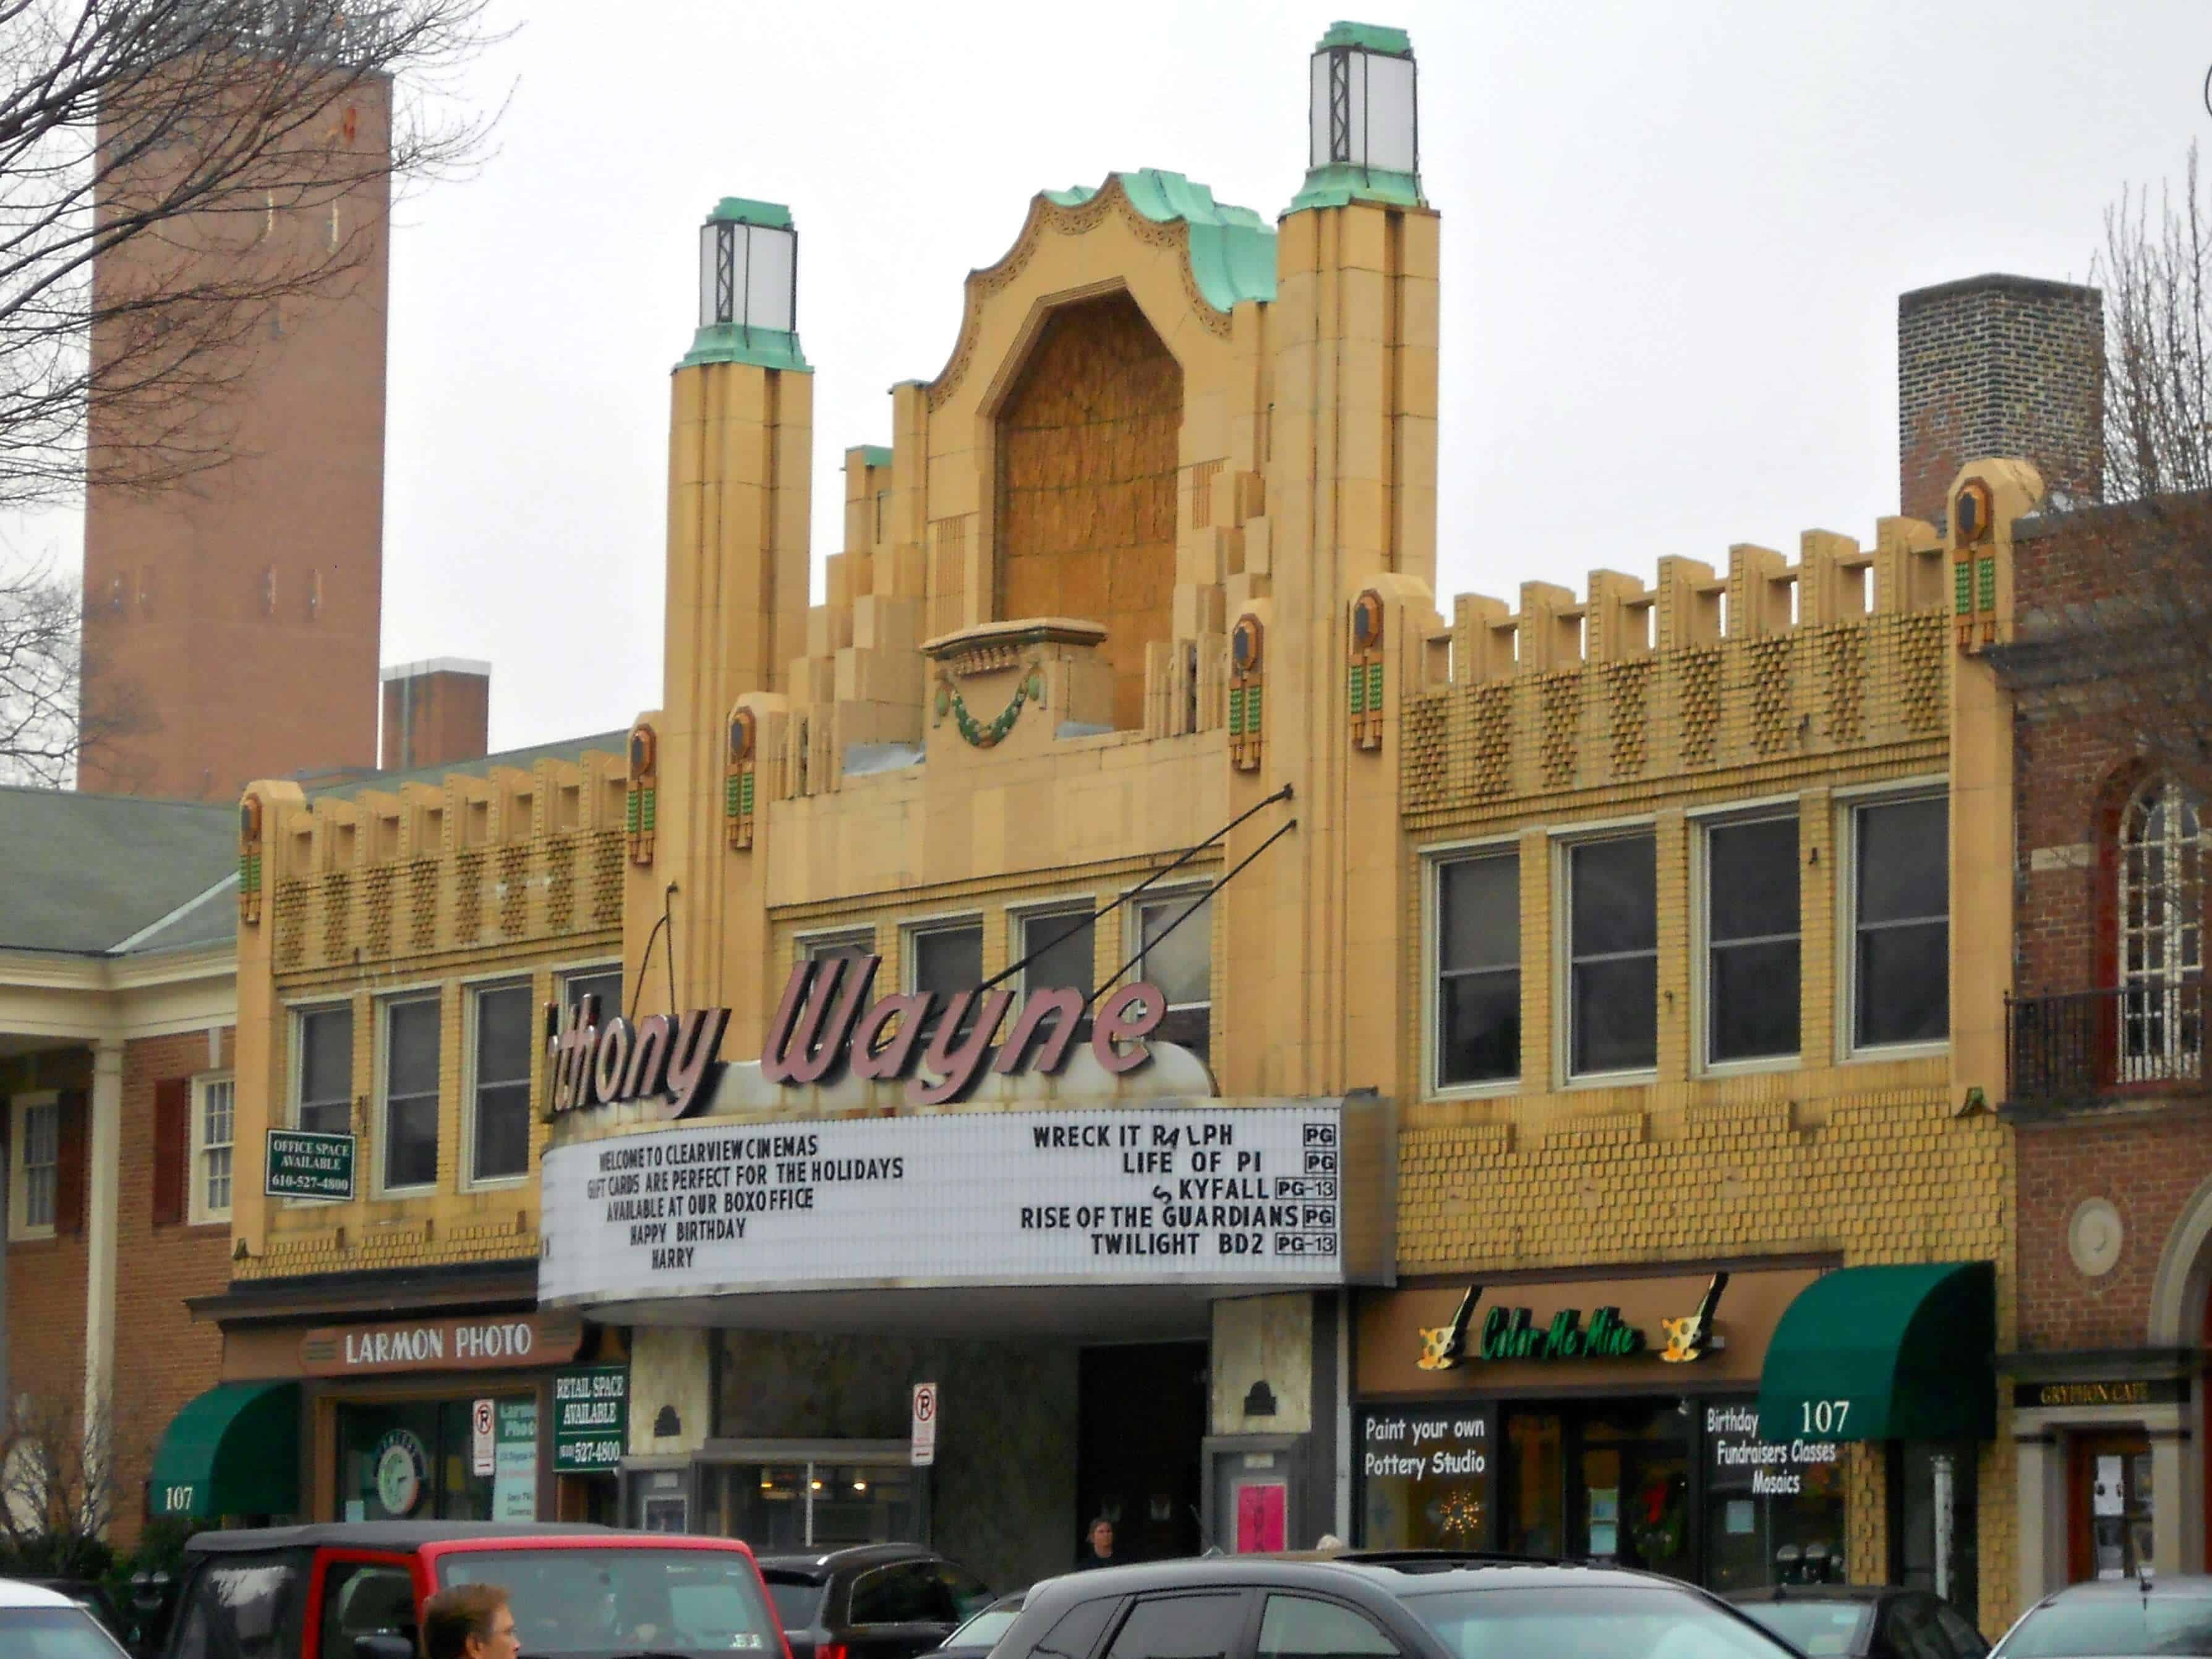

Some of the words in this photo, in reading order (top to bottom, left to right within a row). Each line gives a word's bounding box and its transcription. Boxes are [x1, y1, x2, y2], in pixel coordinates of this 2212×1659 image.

[761, 954, 1168, 1104] Wayne
[273, 1140, 314, 1154] OFFICE
[316, 1143, 349, 1157] SPACE
[1033, 1125, 1111, 1148] WRECK
[1119, 1125, 1141, 1147] IT
[1153, 1124, 1232, 1149] RALPH
[1305, 1128, 1333, 1143] PG
[280, 1155, 342, 1171] AVAILABLE
[665, 1140, 743, 1166] CLEARVIEW
[746, 1135, 818, 1159] CINEMAS
[1123, 1151, 1172, 1174] LIFE
[1191, 1151, 1222, 1173] OF
[1237, 1151, 1262, 1172] PI
[1307, 1155, 1334, 1170] PG
[271, 1174, 349, 1191] 610-527-4800
[587, 1178, 606, 1200] GIFT
[608, 1174, 639, 1196] CARDS
[645, 1171, 668, 1193] ARE
[672, 1166, 731, 1191] PERFECT
[736, 1164, 767, 1187] FOR
[776, 1161, 806, 1183] THE
[811, 1156, 903, 1182] HOLIDAYS
[1278, 1181, 1334, 1196] PG-13
[607, 1197, 664, 1222] AVAILABLE
[668, 1195, 684, 1217] AT
[688, 1193, 717, 1216] OUR
[1021, 1206, 1070, 1229] RISE
[1077, 1206, 1105, 1229] OF
[1111, 1206, 1153, 1228] THE
[1163, 1205, 1299, 1228] GUARDIANS
[1305, 1209, 1331, 1224] PG
[630, 1222, 667, 1246] HAPPY
[676, 1218, 746, 1242] BIRTHDAY
[1091, 1233, 1200, 1255] TWILIGHT
[1218, 1233, 1263, 1255] BD2
[1278, 1237, 1334, 1252] PG-13
[651, 1247, 694, 1270] HARRY
[346, 1328, 443, 1364] LARMON
[455, 1323, 532, 1358] PHOTO
[557, 1377, 591, 1400] RETAIL
[593, 1375, 624, 1398] SPACE
[563, 1402, 617, 1425] AVAILABLE
[1707, 1407, 1759, 1439] Birthday
[1801, 1399, 1850, 1433] 107
[1365, 1417, 1406, 1441] Paint
[1412, 1422, 1448, 1447] your
[1454, 1418, 1485, 1438] own
[574, 1440, 620, 1464] 527-4800
[1717, 1439, 1788, 1465] Fundraisers
[1790, 1438, 1836, 1462] Classes
[1365, 1452, 1426, 1482] Pottery
[1432, 1449, 1485, 1474] Studio
[1753, 1469, 1800, 1494] Mosaics
[166, 1486, 194, 1510] 107
